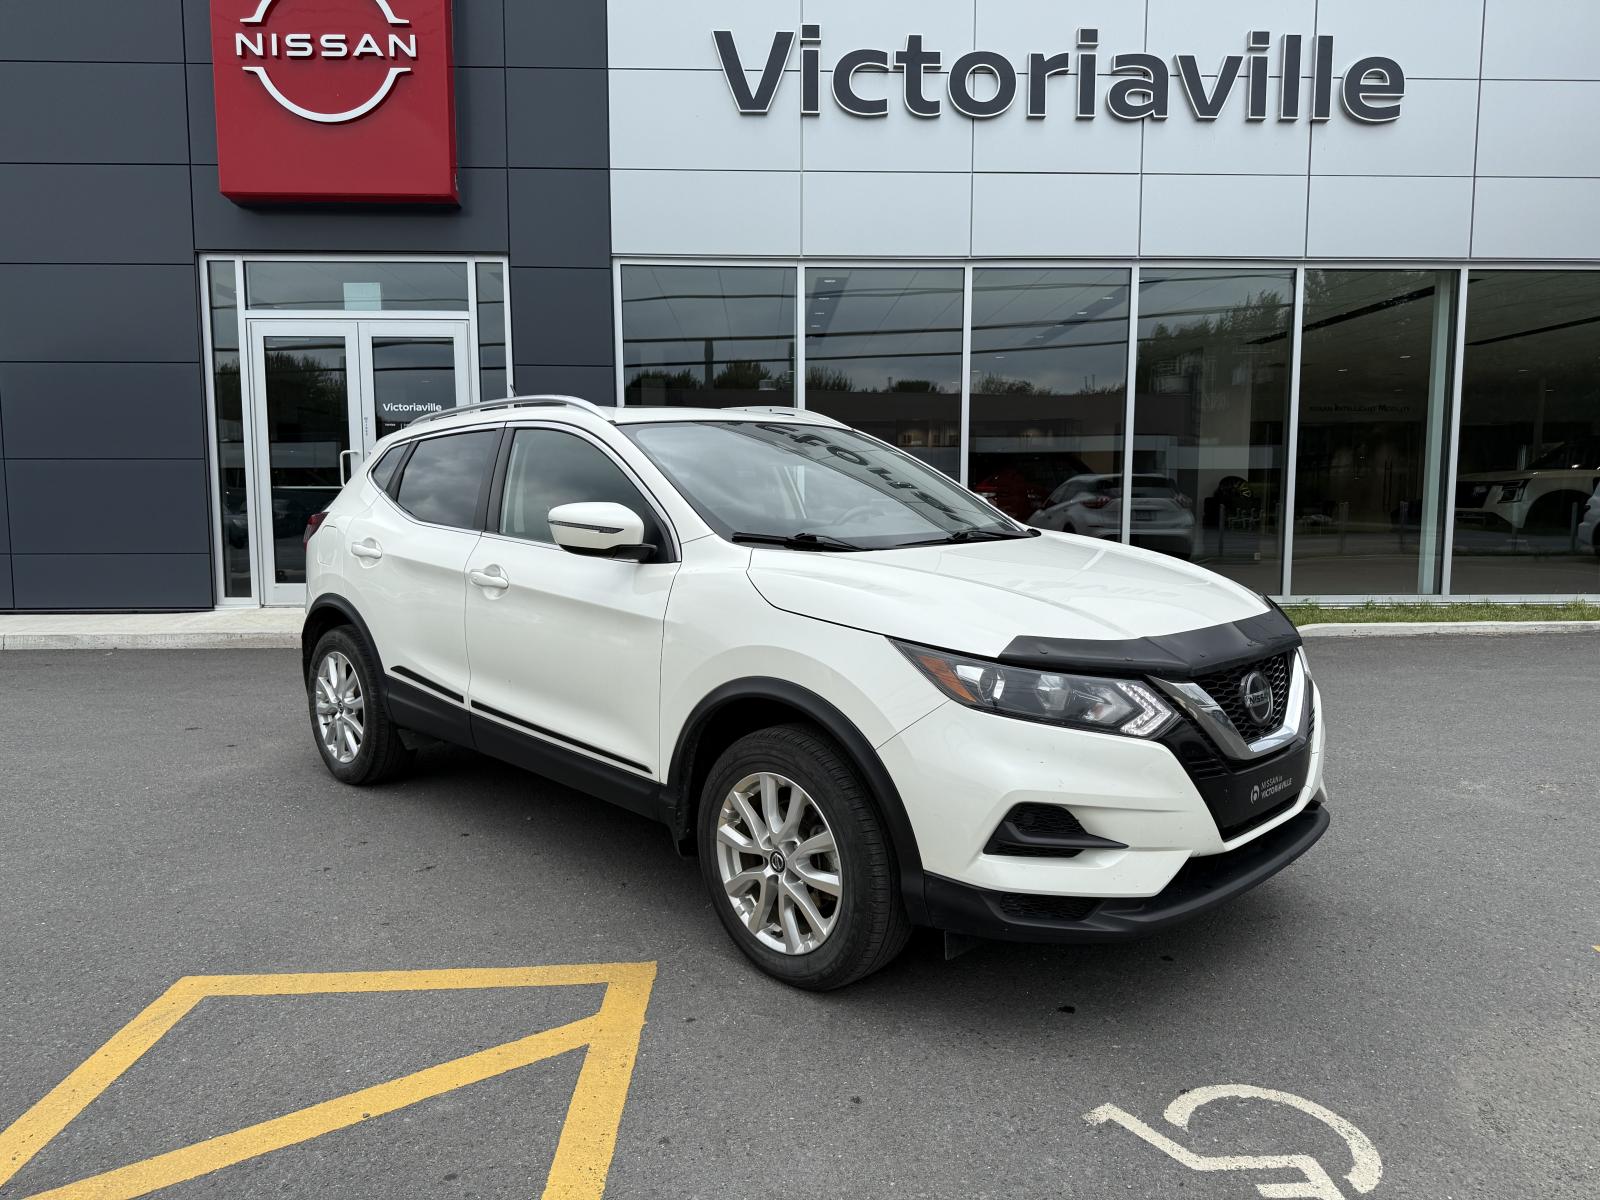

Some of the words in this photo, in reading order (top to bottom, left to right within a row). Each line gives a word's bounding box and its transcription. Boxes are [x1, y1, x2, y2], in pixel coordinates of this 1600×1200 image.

[235, 33, 417, 57] NISSAN
[711, 24, 1406, 125] Victoriaville
[382, 402, 442, 412] Victoriaville
[1249, 691, 1269, 705] NISS
